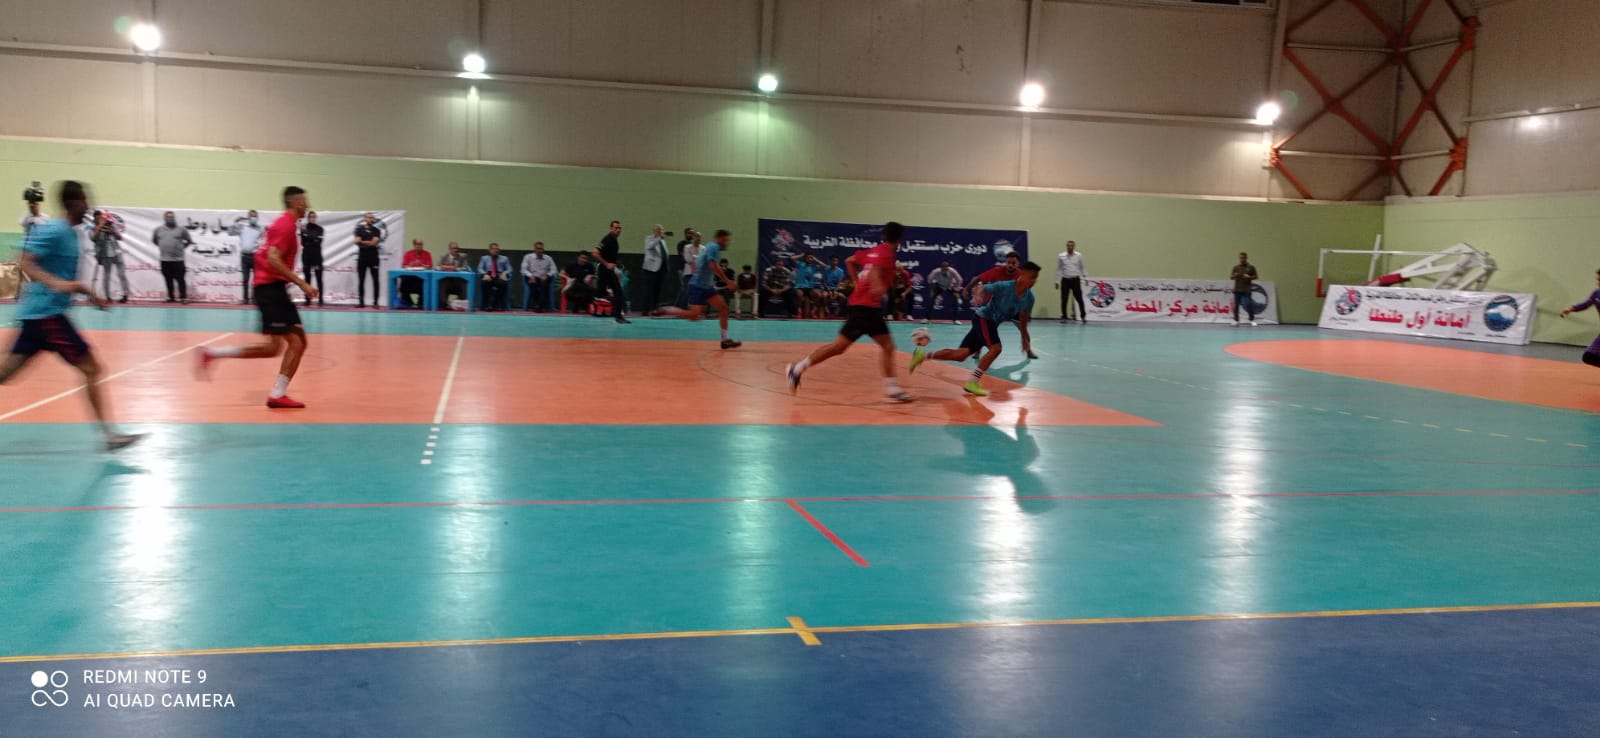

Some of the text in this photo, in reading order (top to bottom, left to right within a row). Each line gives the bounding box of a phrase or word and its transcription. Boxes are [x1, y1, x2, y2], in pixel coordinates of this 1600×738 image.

[803, 234, 837, 248] الغربية
[839, 236, 877, 248] محافظة
[902, 239, 939, 252] مستقبل
[940, 241, 964, 254] حزب
[1125, 298, 1162, 313] المحلة
[1166, 299, 1198, 317] مركز
[1369, 307, 1403, 323] طنطا
